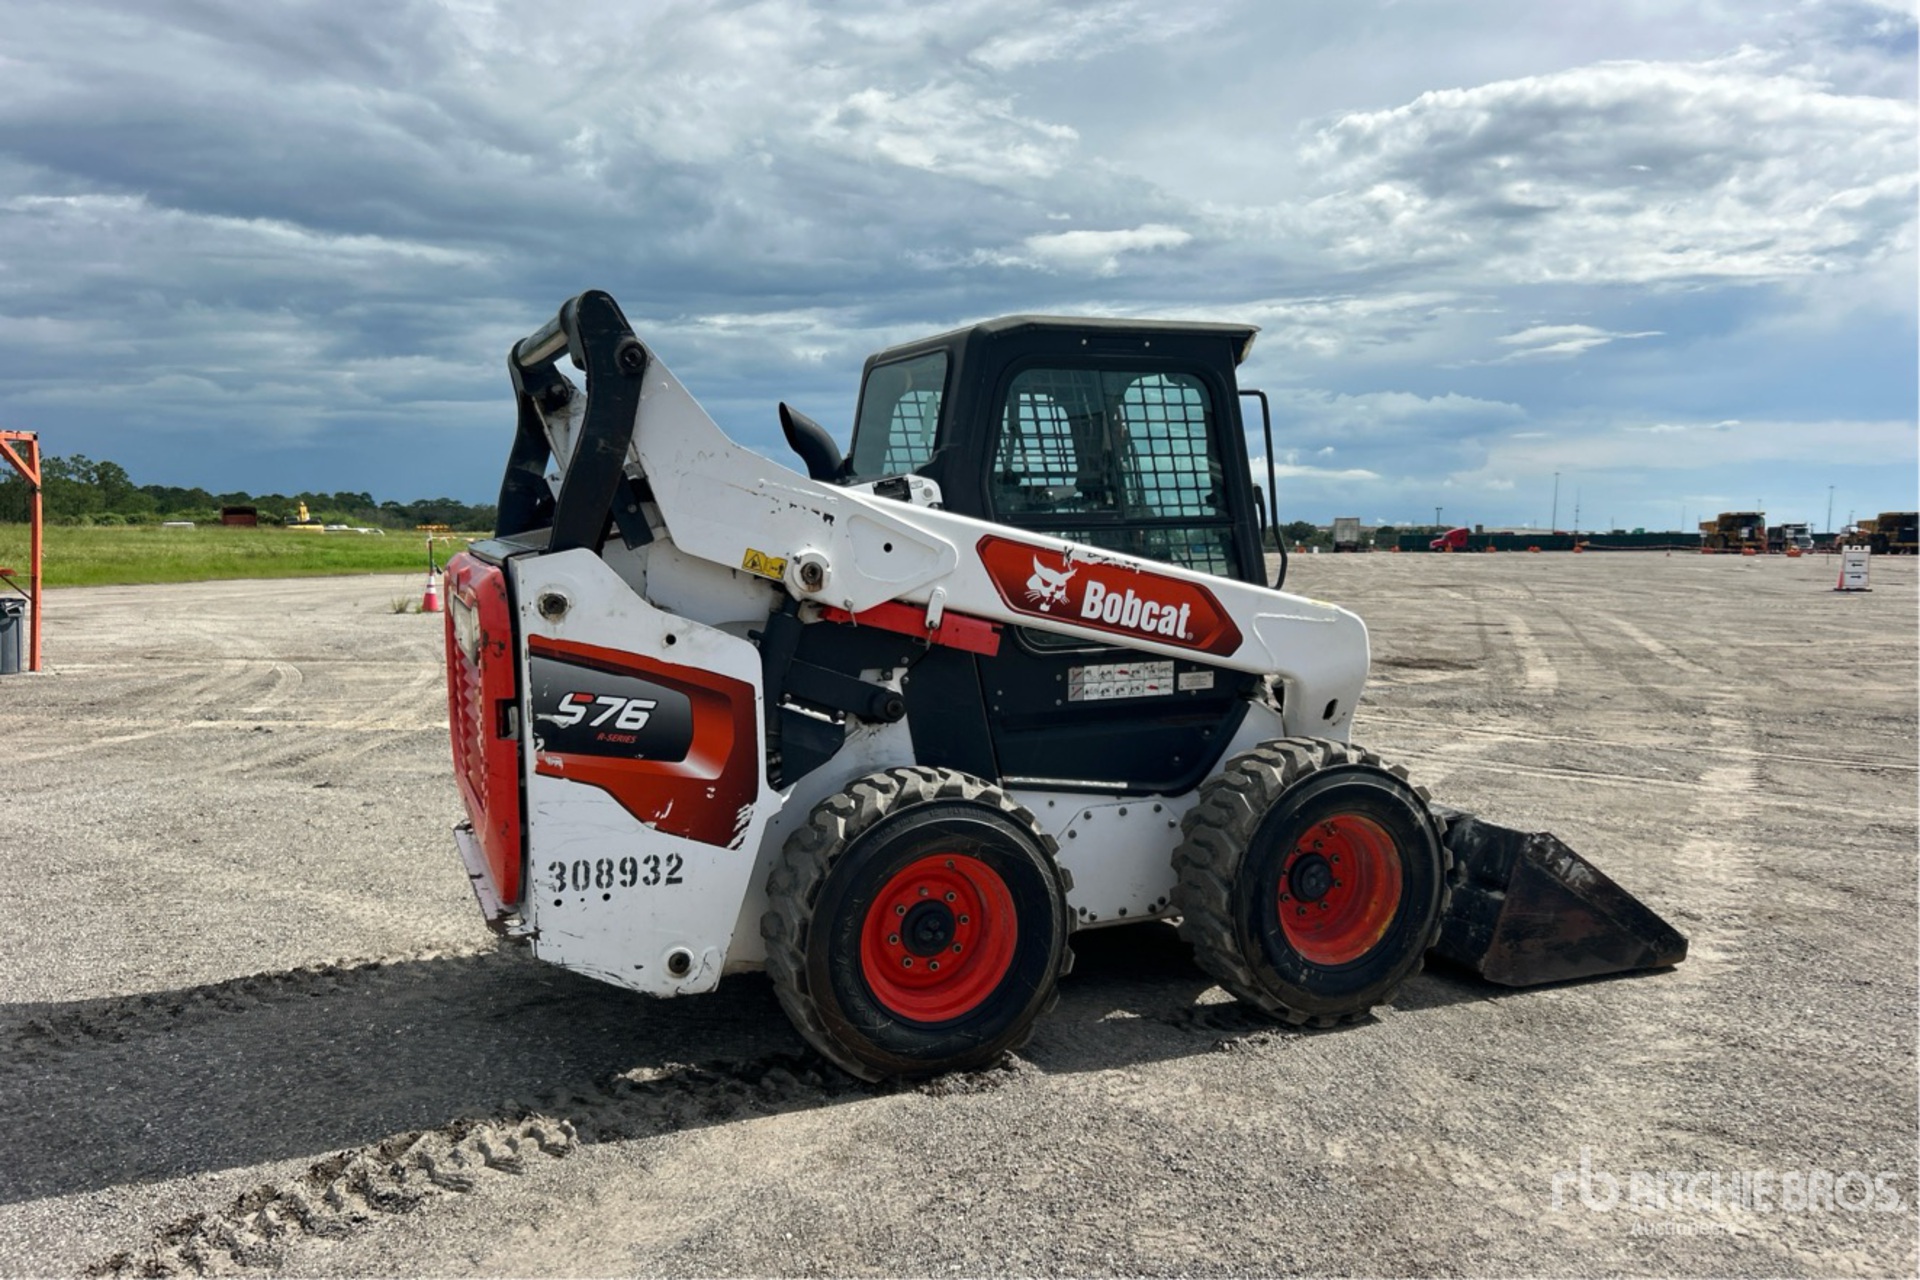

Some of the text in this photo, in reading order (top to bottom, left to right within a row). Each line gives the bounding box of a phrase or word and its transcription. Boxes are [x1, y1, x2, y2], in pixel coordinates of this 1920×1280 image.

[1081, 580, 1190, 639] Bobcat
[558, 692, 657, 730] S76
[597, 732, 636, 743] R-SERIES
[549, 853, 683, 892] 308932
